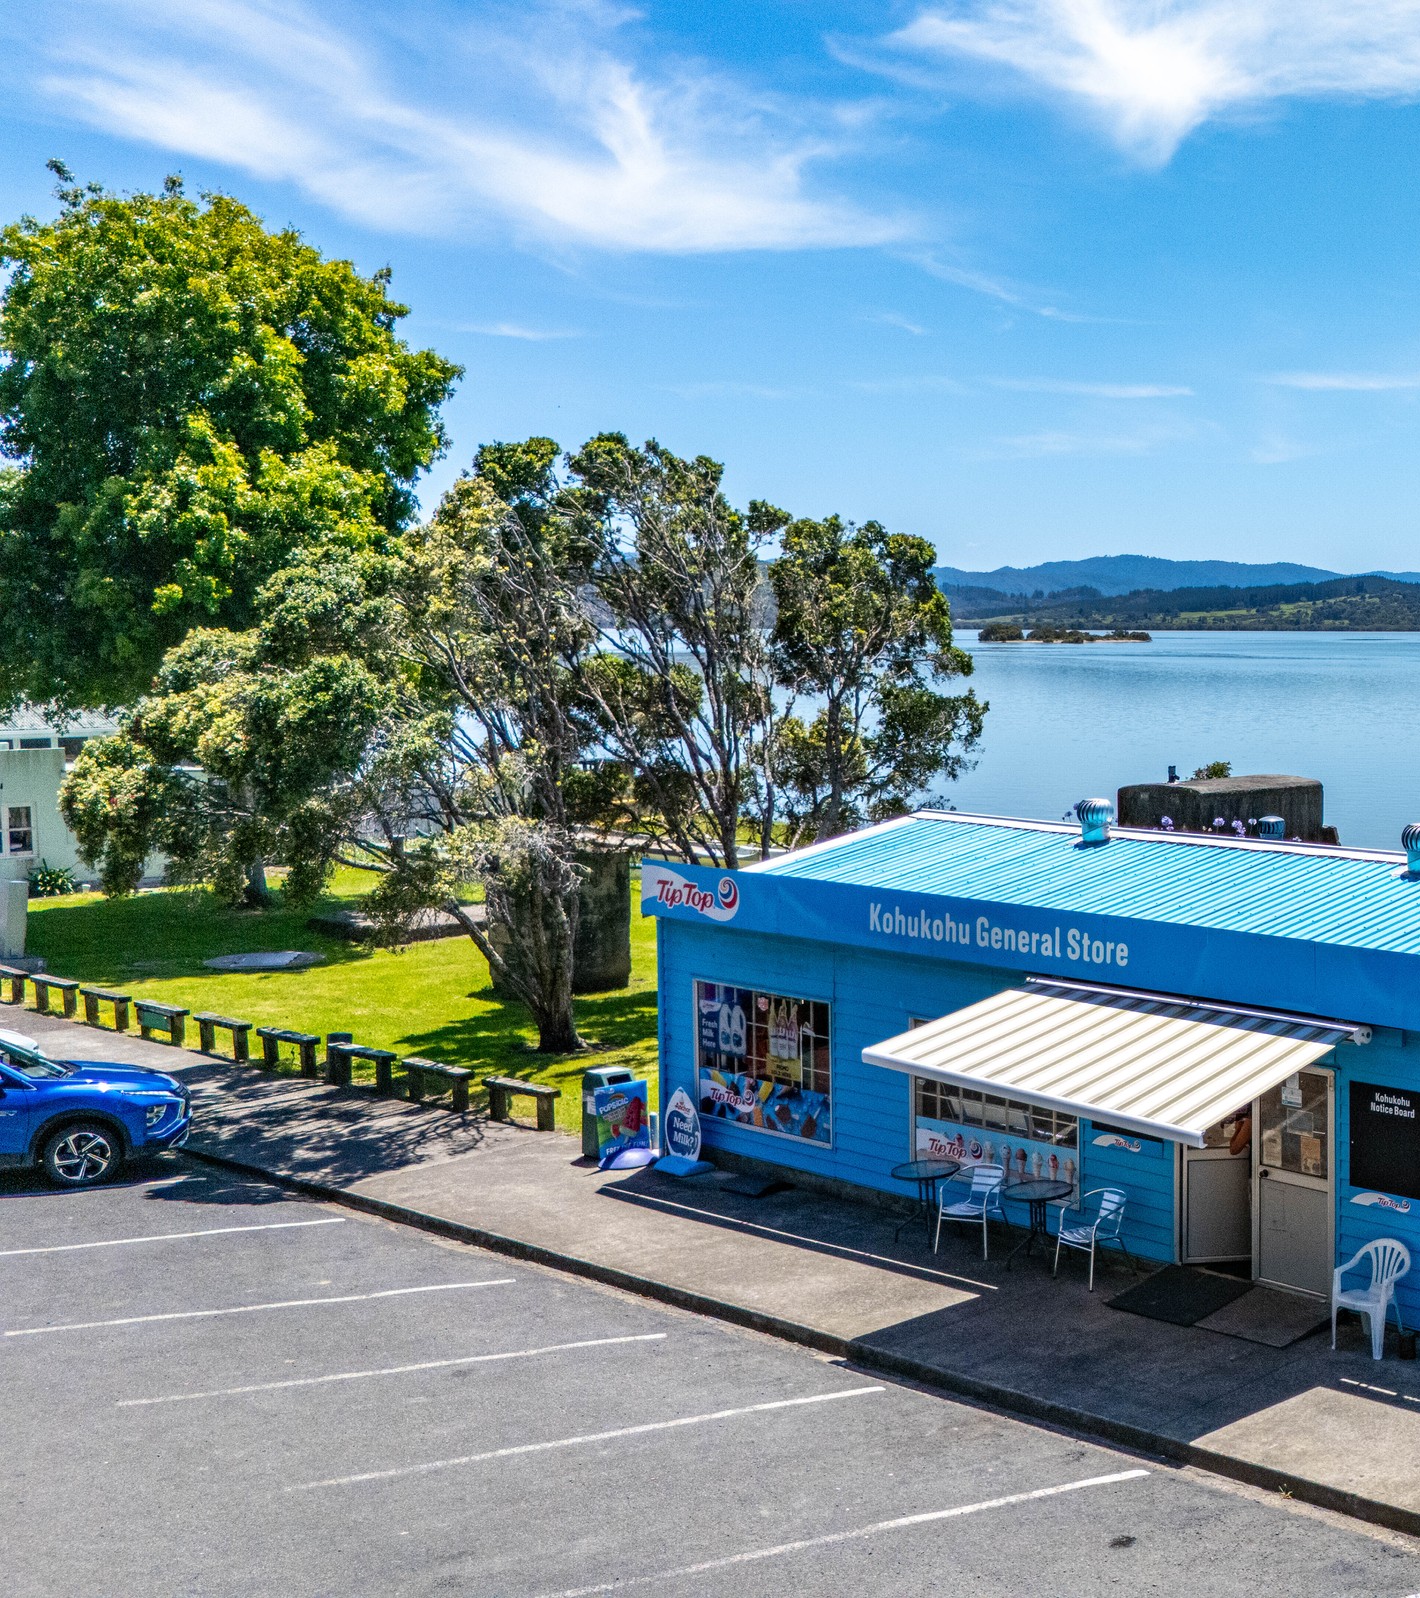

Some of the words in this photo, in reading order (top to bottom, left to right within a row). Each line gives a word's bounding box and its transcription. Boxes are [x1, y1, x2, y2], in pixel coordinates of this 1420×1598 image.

[869, 902, 970, 945] Kohukohu
[976, 916, 1061, 958] General
[1067, 928, 1129, 967] Store
[1375, 1092, 1410, 1107] Kohukohu
[1370, 1101, 1393, 1115] Notice
[1394, 1106, 1415, 1119] Board
[673, 1117, 693, 1133] Need
[673, 1131, 694, 1147] Milk?
